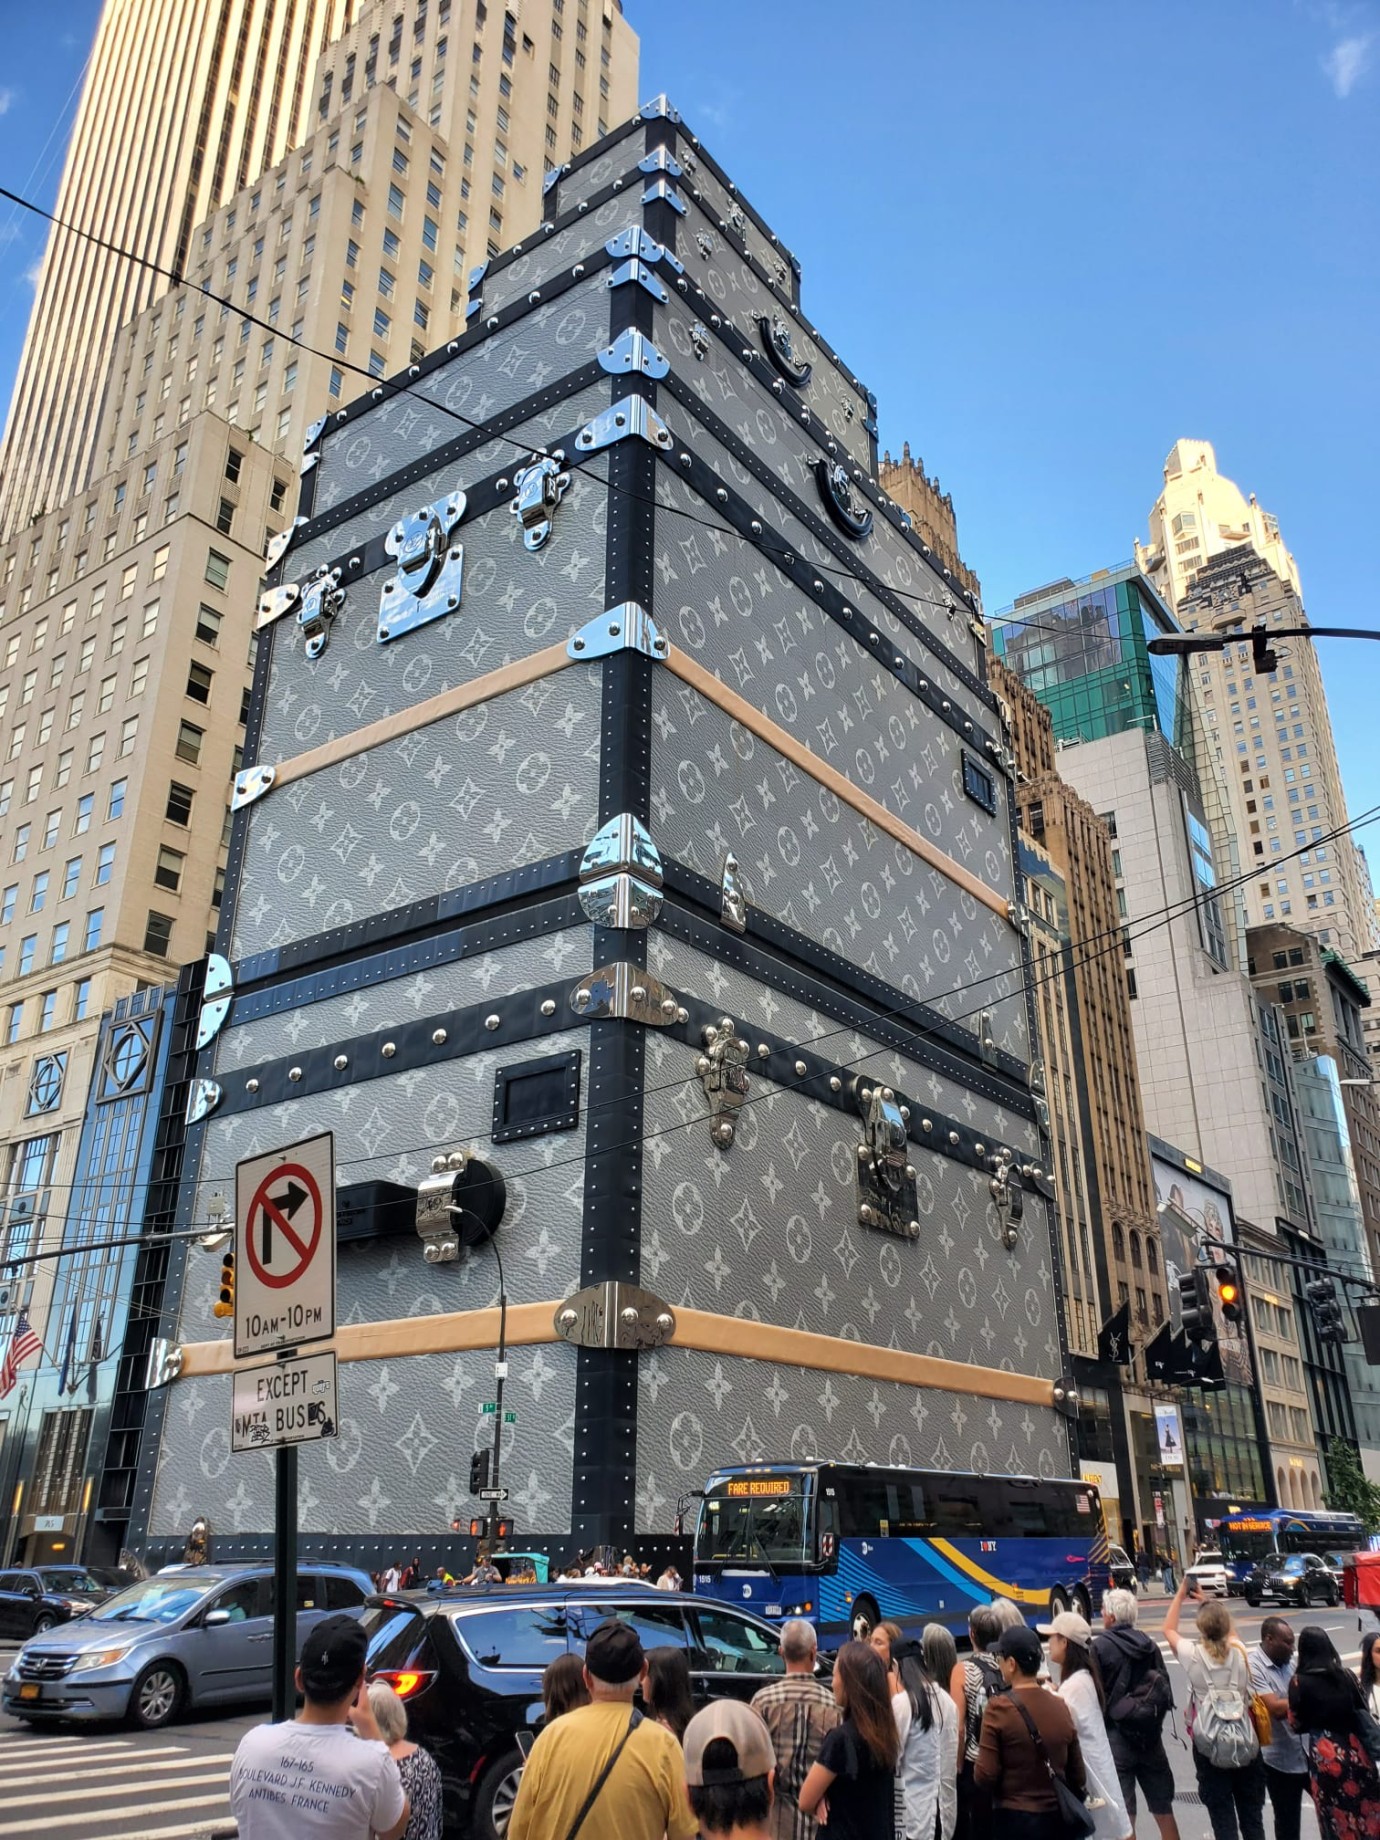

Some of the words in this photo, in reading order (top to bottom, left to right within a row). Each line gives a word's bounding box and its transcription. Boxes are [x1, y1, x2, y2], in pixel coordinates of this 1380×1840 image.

[246, 1304, 322, 1339] 10AM-10PM
[257, 1370, 309, 1402] EXCEPT
[728, 1482, 749, 1496] FARE
[750, 1481, 790, 1495] REQUIRED
[280, 1756, 315, 1773] 167-165
[249, 1788, 287, 1804] ANTIBES
[291, 1794, 330, 1813] FRANCE
[309, 1780, 356, 1799] KENNEDY
